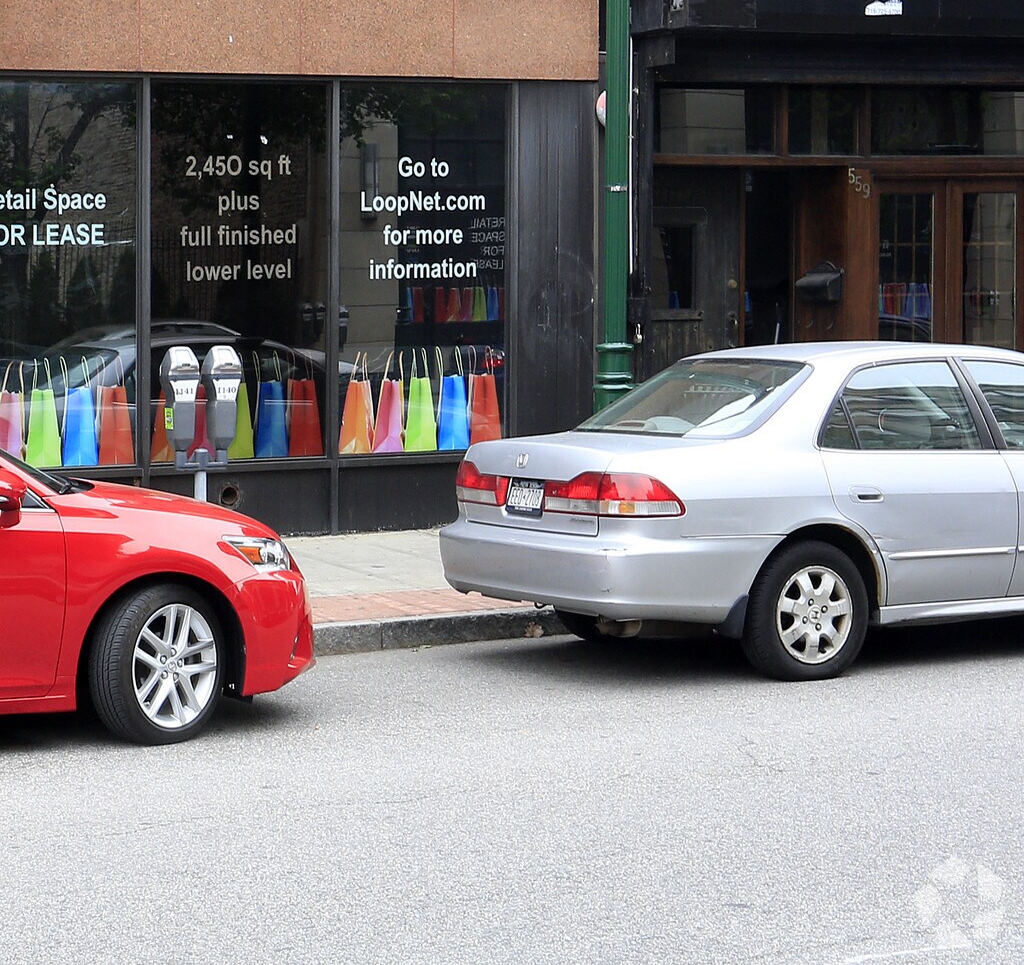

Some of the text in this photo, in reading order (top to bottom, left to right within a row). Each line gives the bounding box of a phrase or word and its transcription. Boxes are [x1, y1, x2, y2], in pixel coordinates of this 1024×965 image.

[185, 155, 292, 180] 2,450 sq ft
[398, 156, 449, 177] Go to
[848, 167, 871, 199] 559
[43, 187, 107, 215] Space
[218, 190, 260, 216] plus
[360, 190, 486, 216] LoopNet.com
[32, 223, 105, 246] LEASE
[180, 223, 296, 246] full finished
[383, 224, 410, 245] for
[416, 227, 463, 245] more
[186, 258, 292, 281] lower level
[369, 258, 477, 280] information
